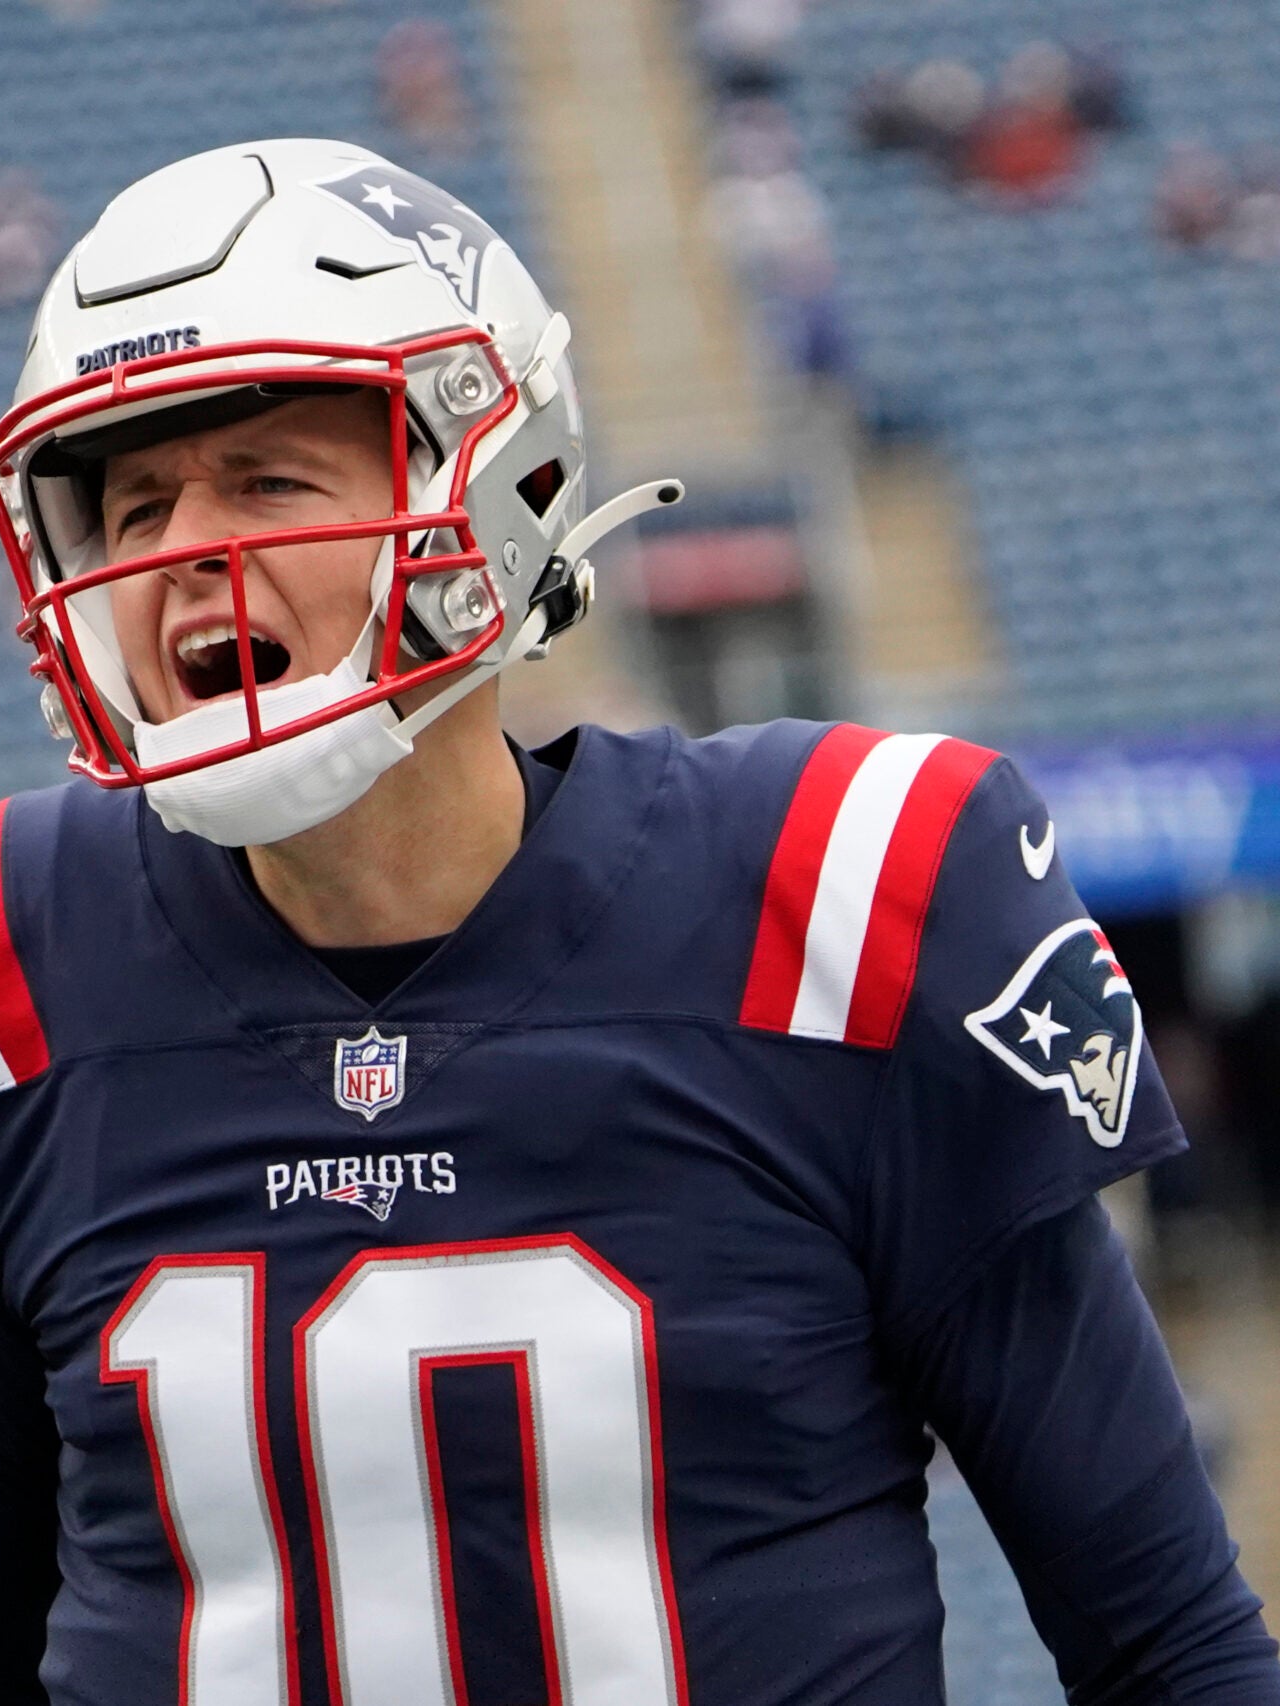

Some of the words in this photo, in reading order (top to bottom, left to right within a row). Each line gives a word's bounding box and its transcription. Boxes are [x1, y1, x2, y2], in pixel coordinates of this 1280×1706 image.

[76, 325, 201, 376] PATRIOTS
[346, 1067, 393, 1102] NFL
[266, 1152, 456, 1210] PATRIOTS
[100, 1232, 690, 1706] 10
